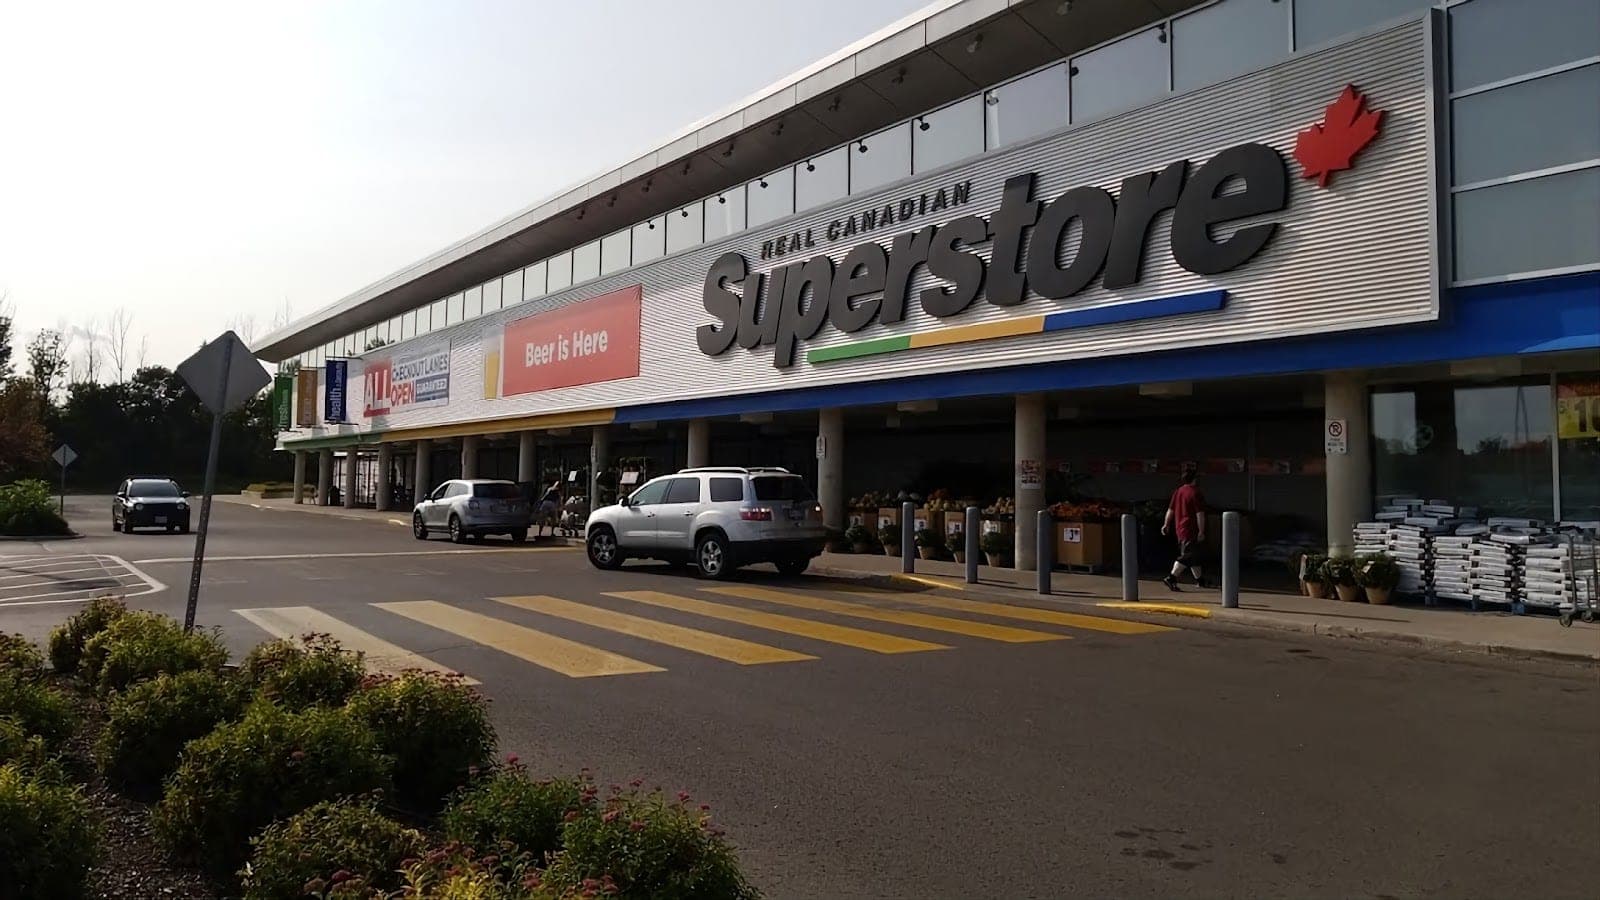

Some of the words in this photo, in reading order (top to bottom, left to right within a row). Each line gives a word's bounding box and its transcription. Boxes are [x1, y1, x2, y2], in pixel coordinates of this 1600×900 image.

[761, 229, 816, 261] REAL
[827, 180, 972, 242] CANADIAN
[696, 142, 1288, 368] Superstore
[525, 342, 556, 368] Beer
[558, 334, 569, 361] is
[572, 329, 609, 358] Here
[327, 387, 342, 420] health
[364, 370, 391, 410] ALL
[391, 380, 416, 407] OPEN
